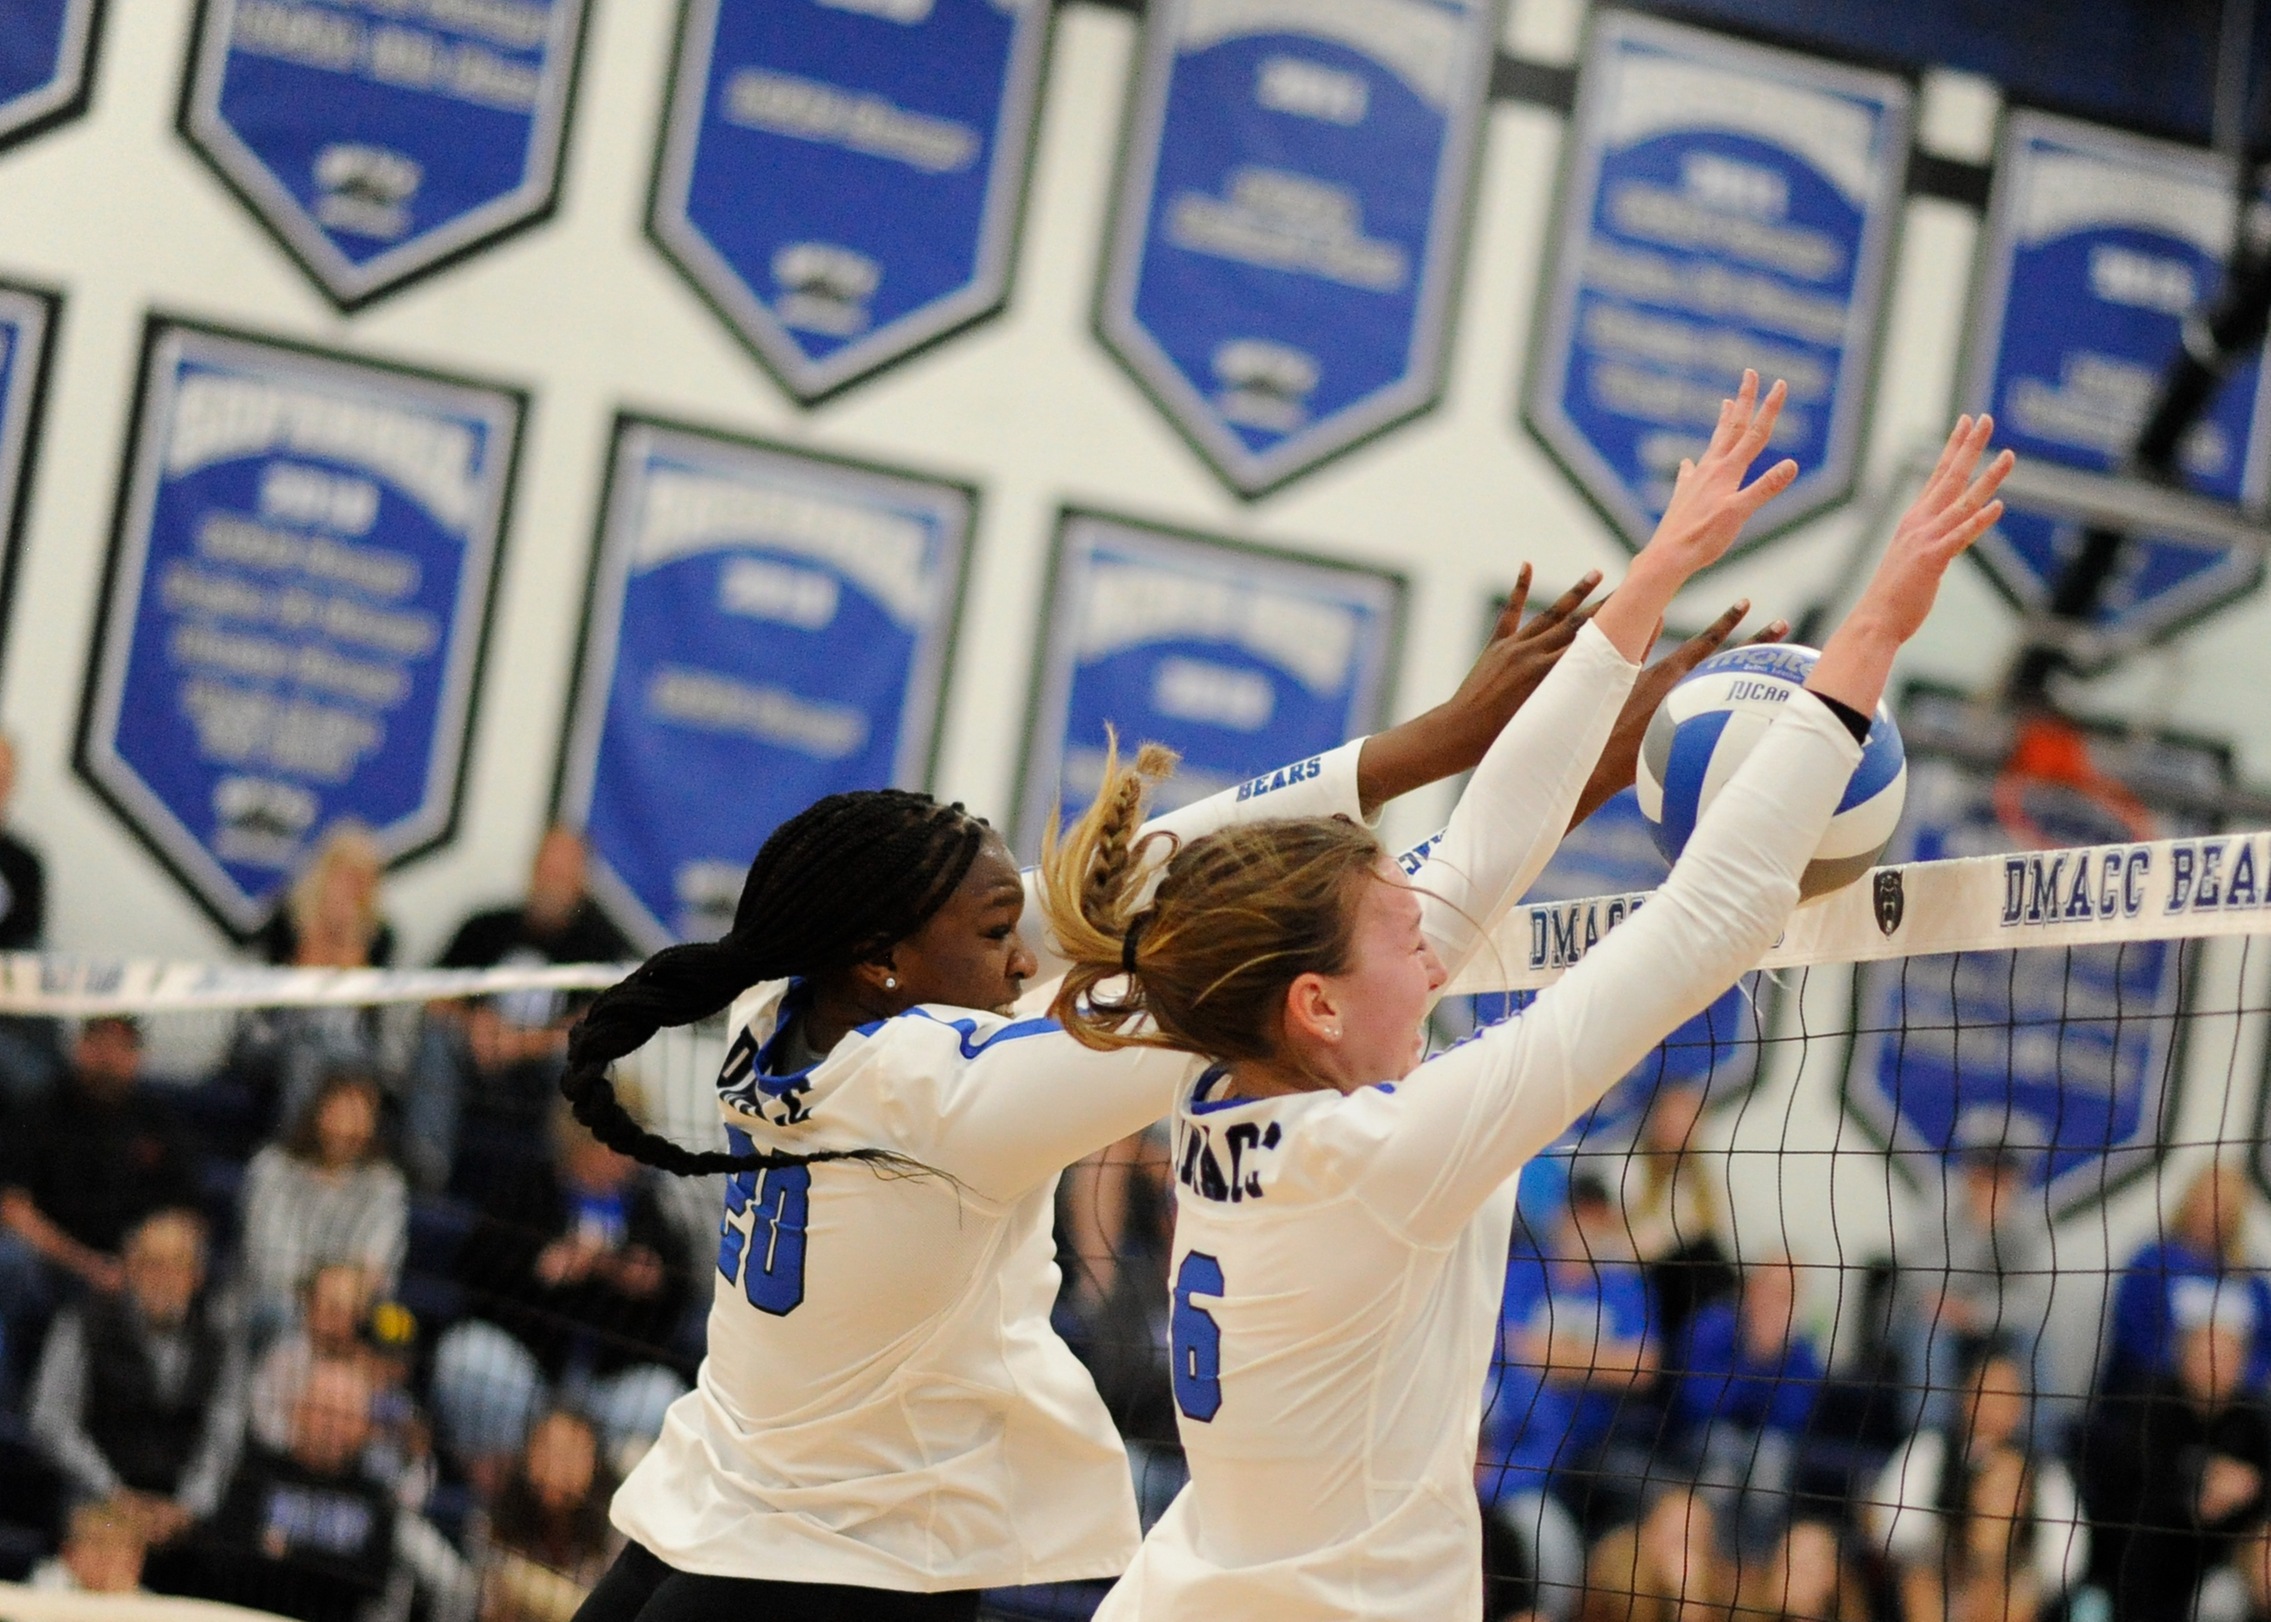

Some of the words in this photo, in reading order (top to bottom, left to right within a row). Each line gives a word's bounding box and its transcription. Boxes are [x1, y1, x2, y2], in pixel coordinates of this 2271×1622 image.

[1707, 649, 1814, 677] molte
[1236, 756, 1322, 802] BEARS
[2000, 846, 2152, 927] DMACC
[2163, 835, 2271, 916] BEA
[1173, 1249, 1225, 1424] 6
